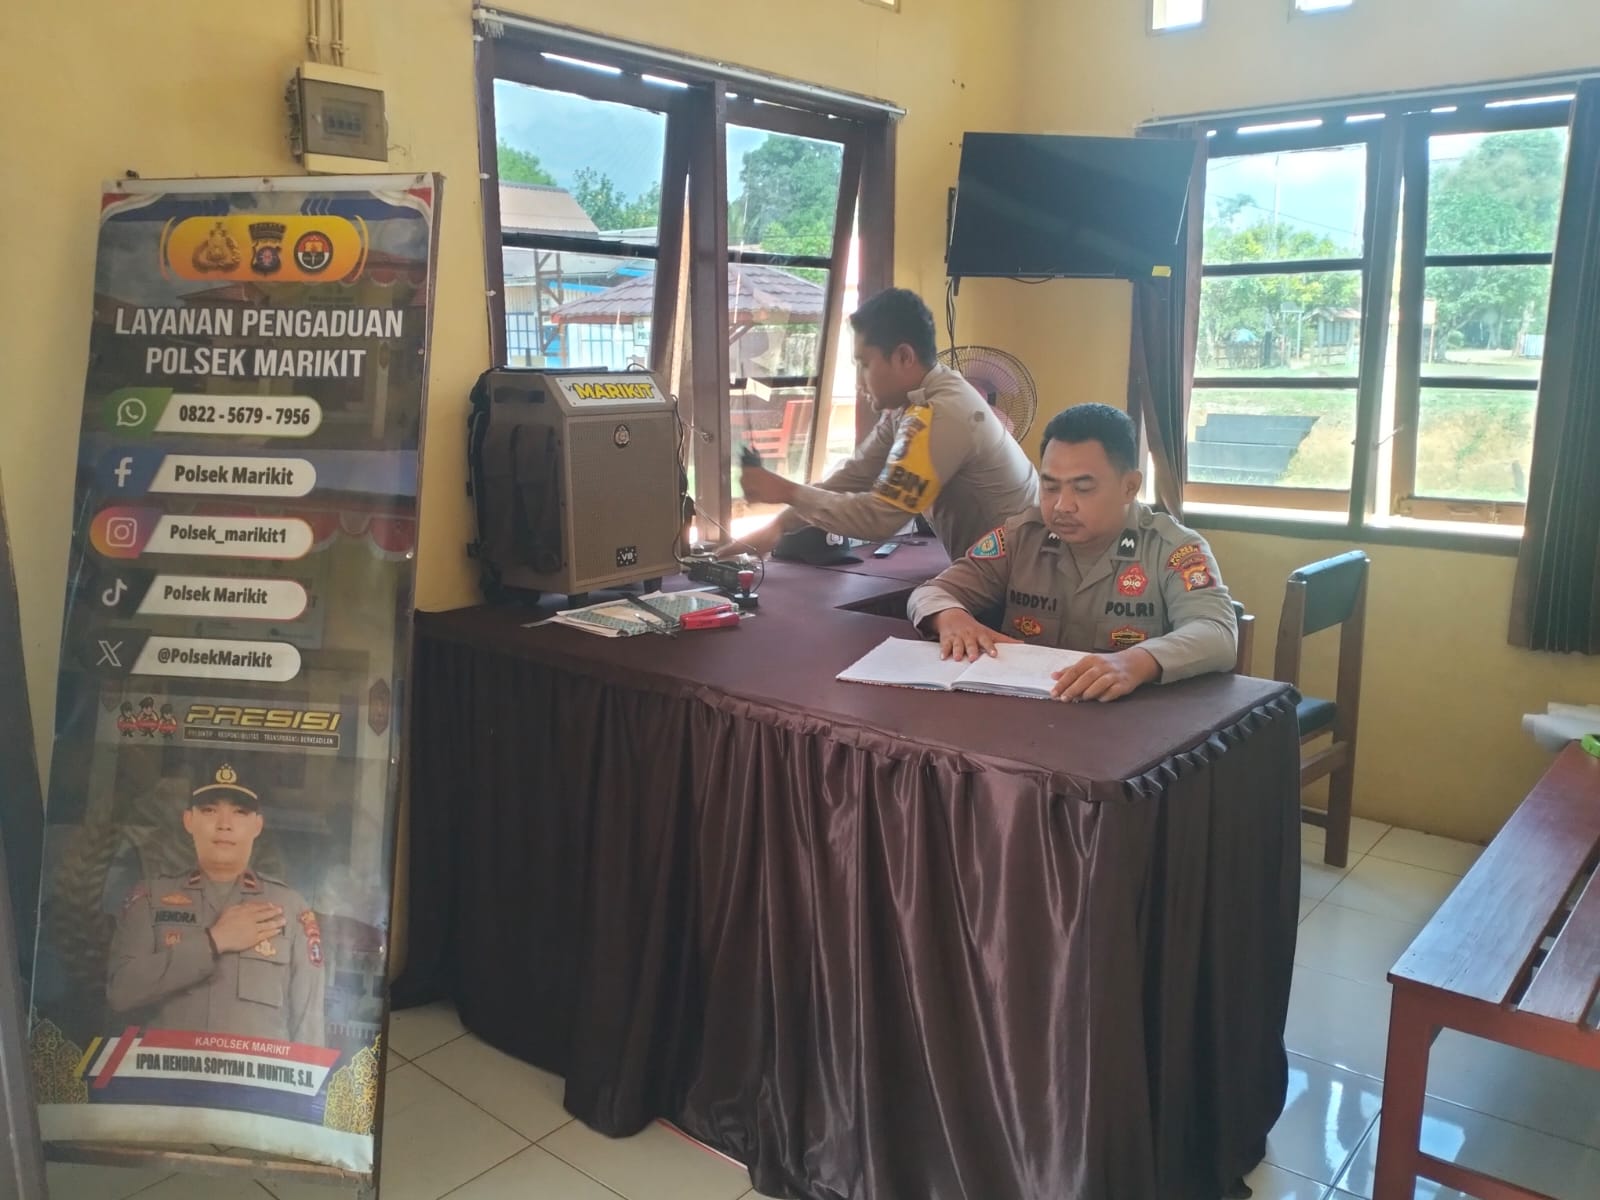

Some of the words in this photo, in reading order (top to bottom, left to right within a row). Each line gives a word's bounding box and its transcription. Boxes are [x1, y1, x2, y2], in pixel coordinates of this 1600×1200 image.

[115, 307, 234, 336] LAYANAN
[241, 308, 404, 338] PENGADUAN
[145, 347, 247, 376] POLSEK
[253, 349, 367, 378] MARIKIT
[572, 382, 655, 400] MARIKIT
[179, 405, 216, 423] 0822
[227, 406, 263, 424] 5679
[275, 408, 310, 425] 7956
[174, 465, 228, 484] Polsek
[231, 466, 294, 486] Marikit
[169, 524, 287, 544] Polsek_marikit1
[163, 585, 210, 602] Polsek
[213, 587, 268, 605] Marikit
[1105, 601, 1154, 617] POLRI
[157, 648, 273, 669] @PolsekMarikit
[185, 704, 342, 731] PRESISI
[154, 910, 197, 925] HENDRA
[195, 1036, 250, 1050] KAPOLSEK
[251, 1042, 291, 1056] MARIKIT
[136, 1053, 160, 1070] IPDA
[162, 1055, 202, 1073] HENDRA
[204, 1058, 245, 1077] SOPIYAN
